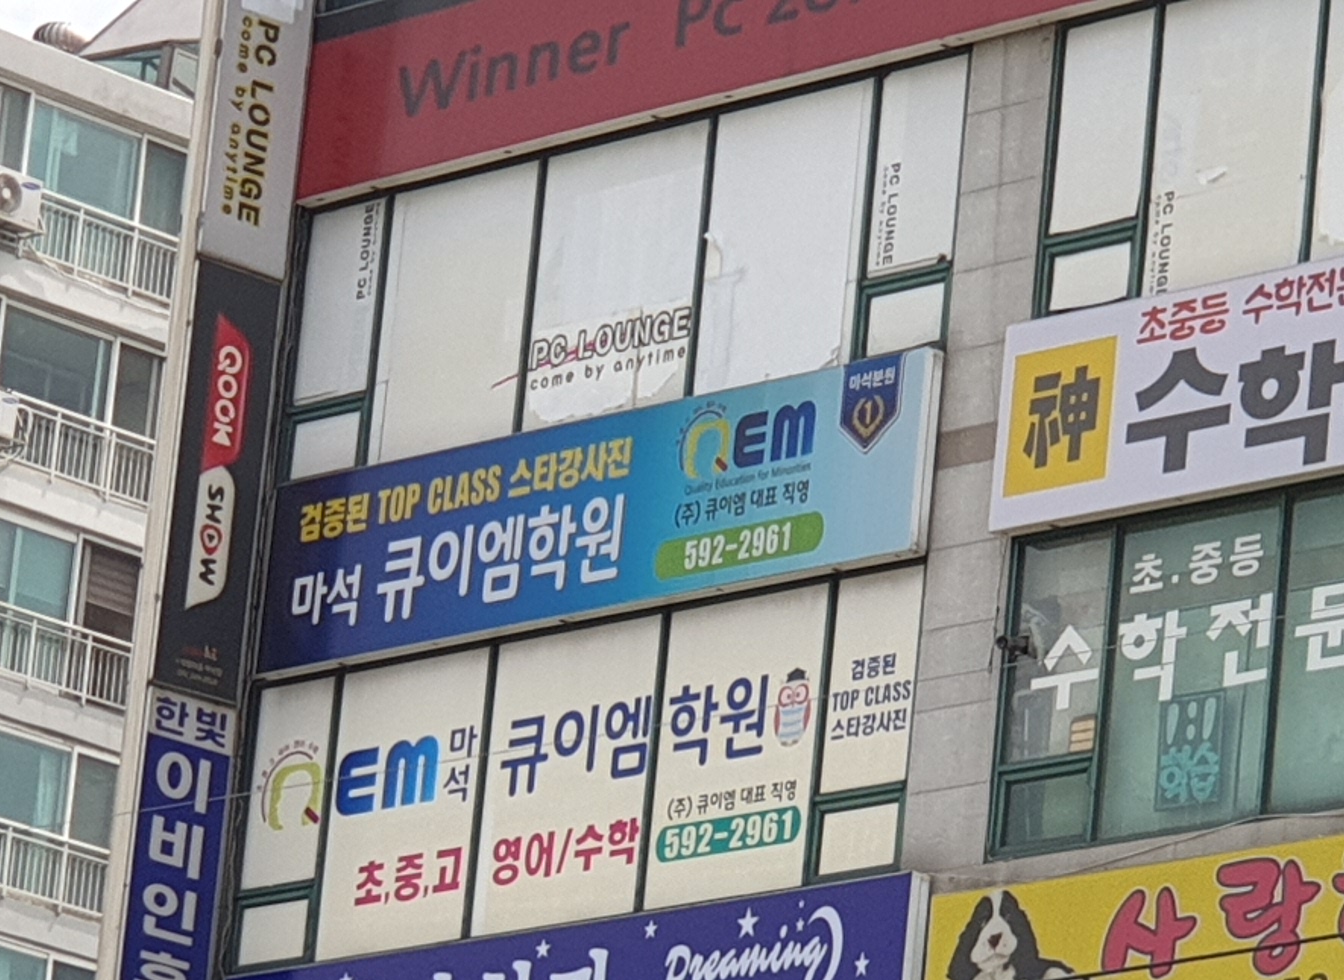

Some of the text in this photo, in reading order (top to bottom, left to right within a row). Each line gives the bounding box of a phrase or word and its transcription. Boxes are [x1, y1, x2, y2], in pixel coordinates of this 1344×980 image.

[398, 20, 629, 118] Winner
[222, 15, 253, 216] come by anytime
[238, 19, 280, 227] PC LOUNGE
[882, 162, 901, 266] PC LOUNGE
[1160, 190, 1175, 216] PC
[356, 277, 367, 300] PC
[529, 305, 692, 372] PC LOUNGE
[1136, 292, 1231, 345] 초중등
[530, 344, 687, 392] come by anytime
[1023, 365, 1101, 470] 神
[299, 437, 635, 543] 검증된 TOP CLASS 스타강사진
[674, 479, 810, 528] (주) 큐이엠 대표 직영
[291, 493, 626, 627] 마석 큐이엠학원
[683, 521, 792, 570] 592-2961
[1129, 533, 1264, 595] 초.중등
[851, 652, 896, 681] 검증된
[156, 696, 227, 748] 한빛
[832, 680, 912, 713] TOP CLASS
[443, 674, 769, 802] 마석 큐이엠학원
[830, 708, 907, 741] 스타강사진
[667, 779, 797, 820] (주) 큐이엠 대표 직영
[664, 809, 794, 859] 592-2961
[354, 817, 640, 907] 초,중,고 영어/수학
